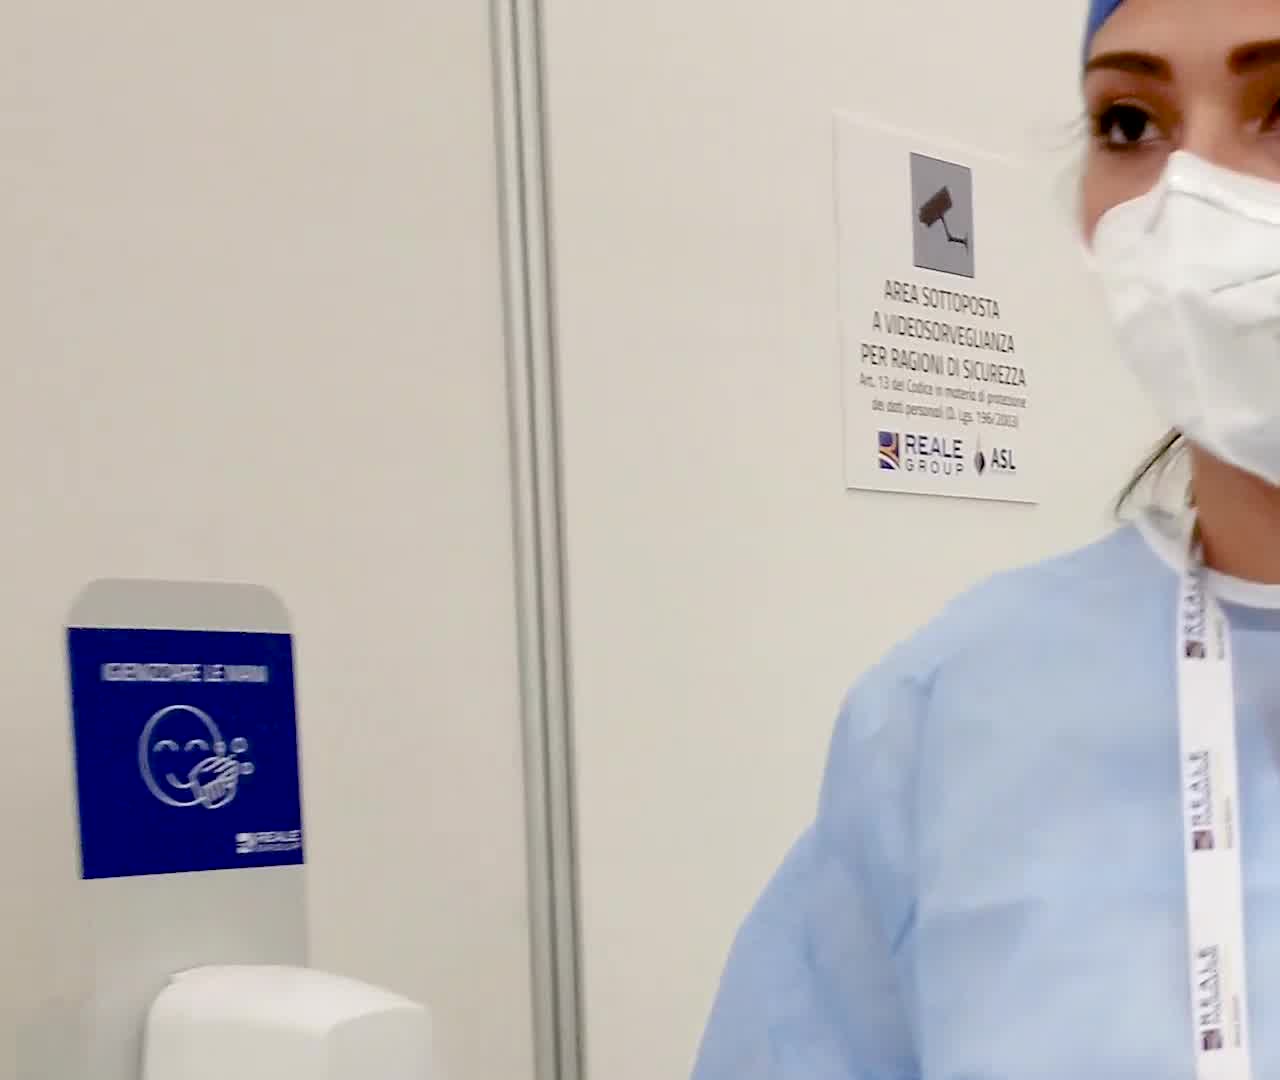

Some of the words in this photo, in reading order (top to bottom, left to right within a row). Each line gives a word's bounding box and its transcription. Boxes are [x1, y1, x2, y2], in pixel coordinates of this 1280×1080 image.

[884, 279, 919, 304] AREA
[922, 286, 1000, 319] SOTTOPOSTA
[873, 311, 881, 331] A
[884, 314, 1015, 354] VIDEOSORVEGLIANZA
[861, 343, 887, 367] PER
[891, 348, 944, 376] RAGIONI
[948, 357, 960, 377] DI
[963, 359, 1027, 387] SICUREZZA
[905, 434, 964, 459] REALE
[991, 448, 1016, 470] ASL
[905, 458, 965, 477] GROUP
[203, 664, 224, 682] LE
